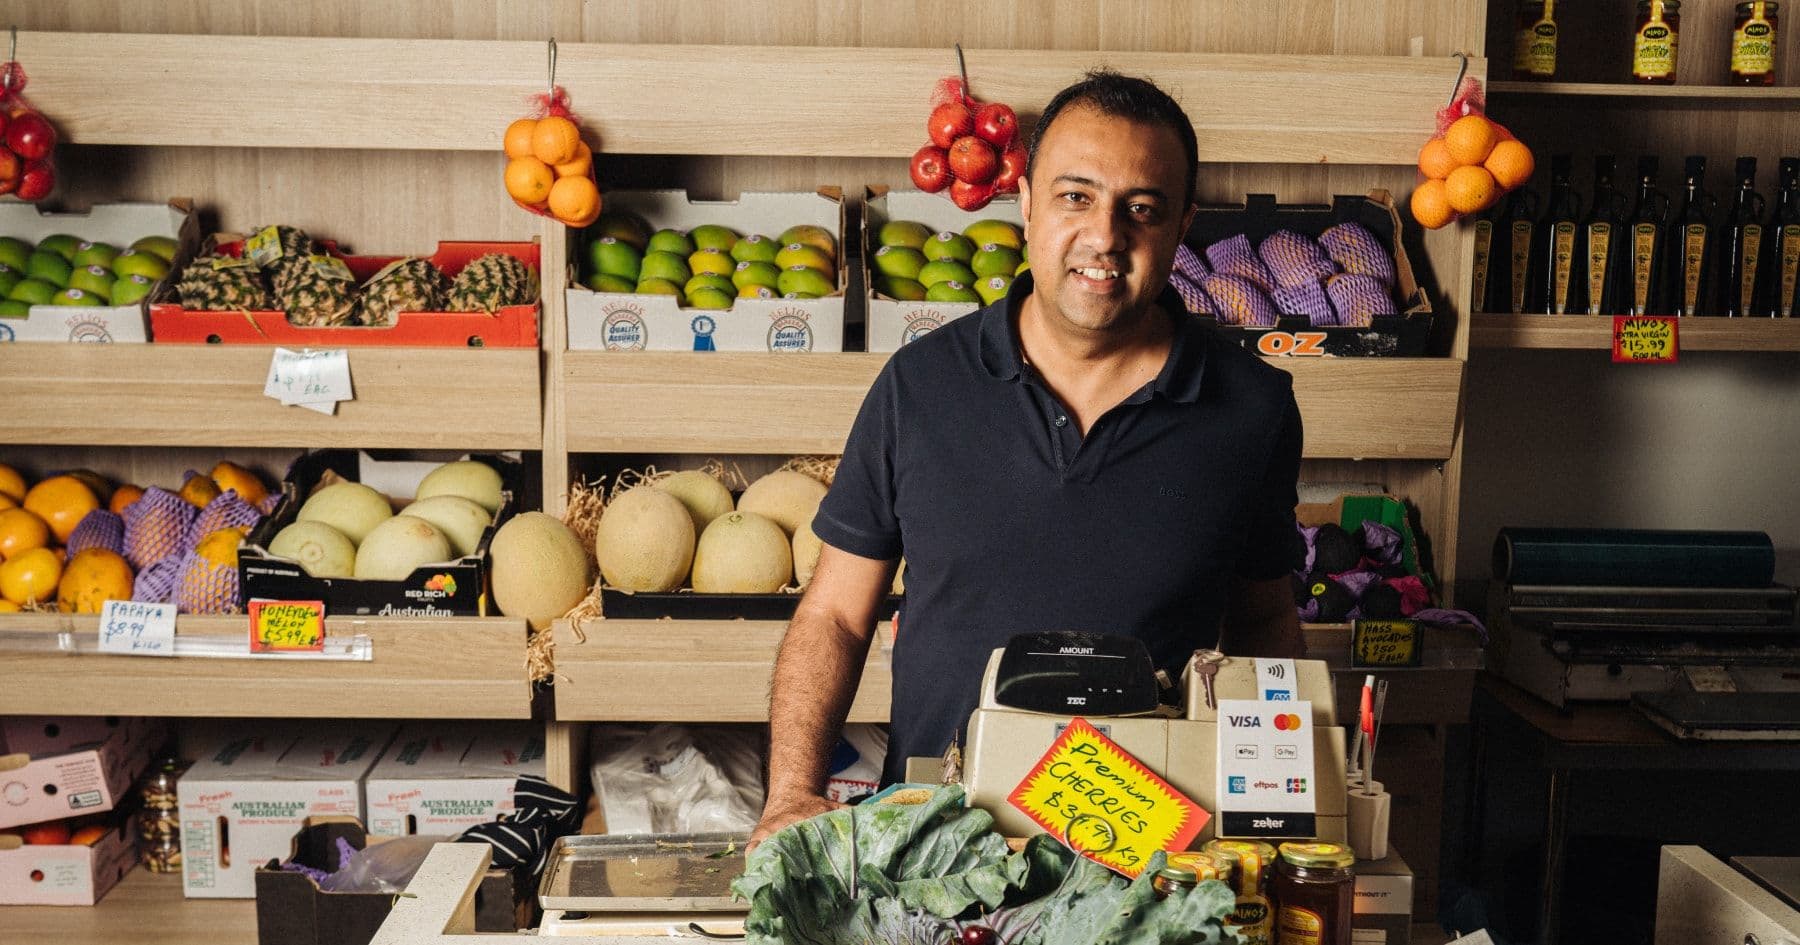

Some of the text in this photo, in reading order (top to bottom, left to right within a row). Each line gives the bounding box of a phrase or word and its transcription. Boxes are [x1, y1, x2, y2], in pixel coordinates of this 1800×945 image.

[602, 302, 646, 316] HELIOS
[769, 306, 812, 321] HELIOS
[904, 309, 946, 322] HELIOS
[1624, 317, 1668, 331] MINOS
[775, 331, 805, 339] QUALITY
[1616, 330, 1670, 339] EXTRA VIRGIN
[1257, 331, 1327, 355] OZ
[1621, 339, 1666, 350] $15.99
[405, 590, 446, 598] RED RICH
[111, 602, 162, 618] PAPAYA
[378, 603, 452, 617] Australian
[267, 618, 306, 628] MELON
[1365, 624, 1393, 634] HASS
[1059, 647, 1095, 655] AMOUNT
[1066, 697, 1087, 705] TEC
[1228, 715, 1262, 727] VISA
[1070, 742, 1156, 810] Premium
[1253, 780, 1279, 789] eftpos
[1049, 761, 1149, 834] CHERRIES
[232, 801, 305, 810] AUSTRALIAN
[420, 799, 494, 808] AUSTRALIAN
[241, 809, 297, 818] PRODUCE
[430, 807, 486, 815] PRODUCE
[1252, 817, 1285, 829] zeller
[1232, 906, 1264, 919] MINOS
